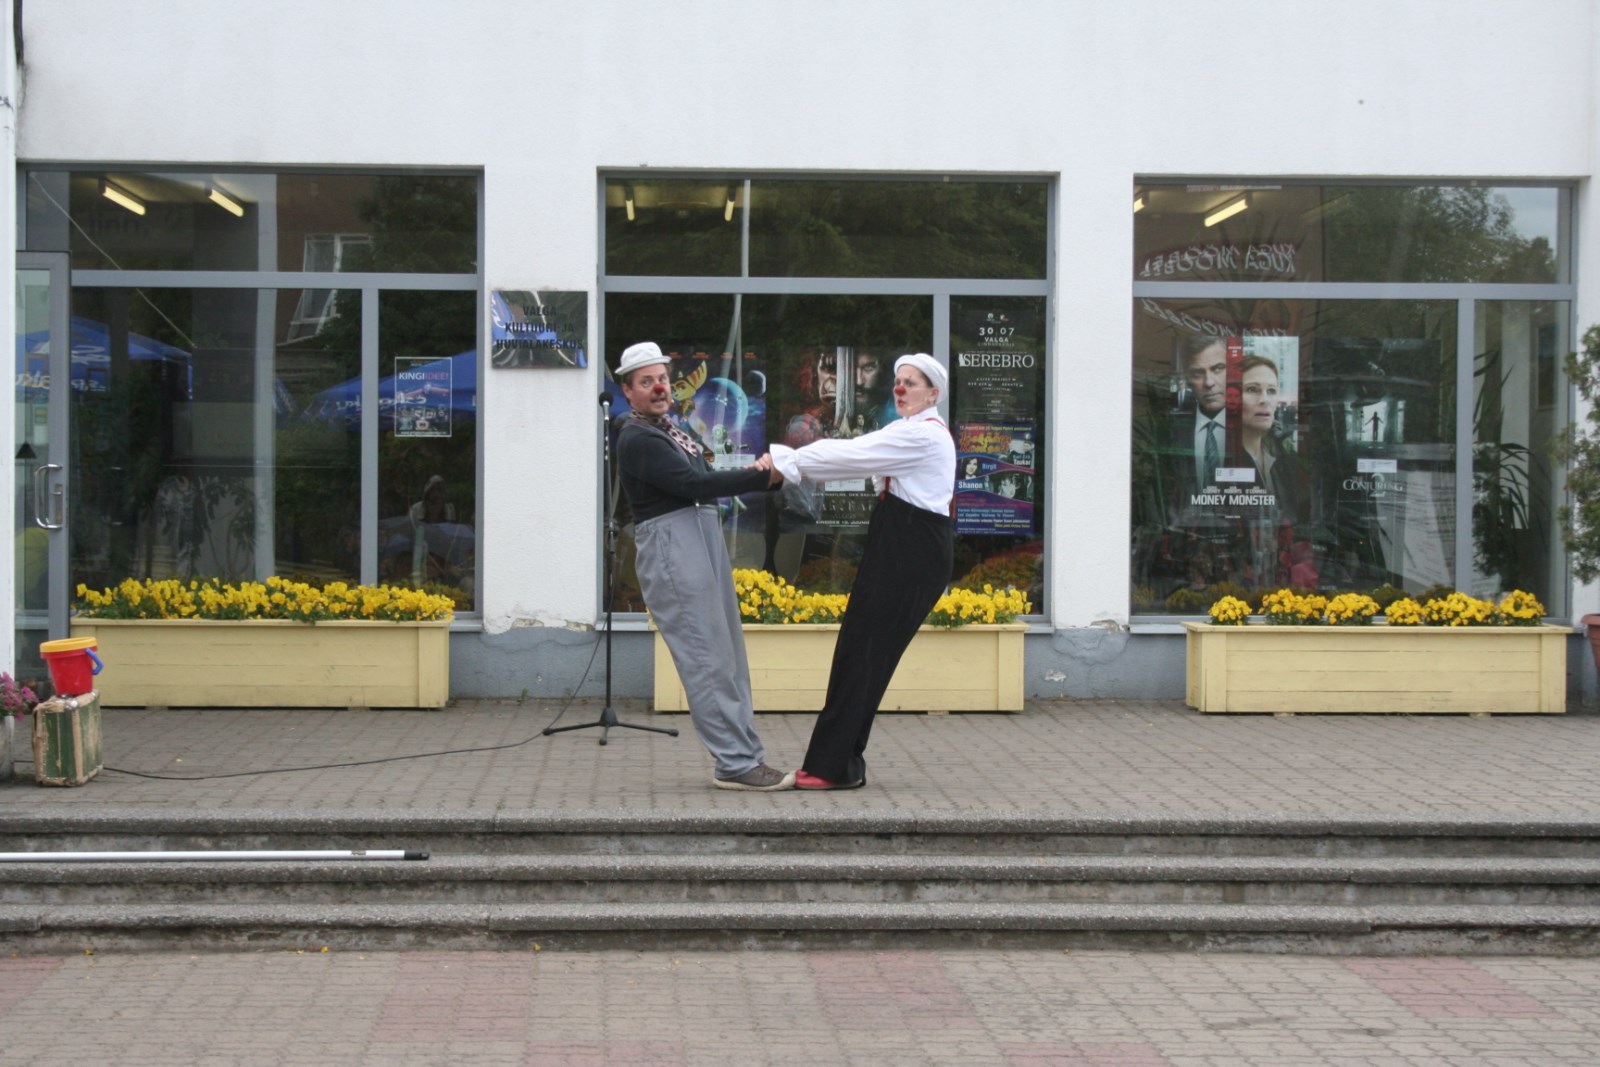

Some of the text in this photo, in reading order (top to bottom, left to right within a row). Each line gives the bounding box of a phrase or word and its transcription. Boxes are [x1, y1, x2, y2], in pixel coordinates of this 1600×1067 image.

[523, 305, 557, 316] VALGA
[562, 322, 574, 332] JA
[496, 339, 584, 349] HUVIALAKESKUS
[963, 353, 1035, 368] SEREBRO
[958, 481, 983, 489] Shanon
[1343, 479, 1403, 492] CONJURING
[1191, 495, 1275, 505] MONEY MONSTER
